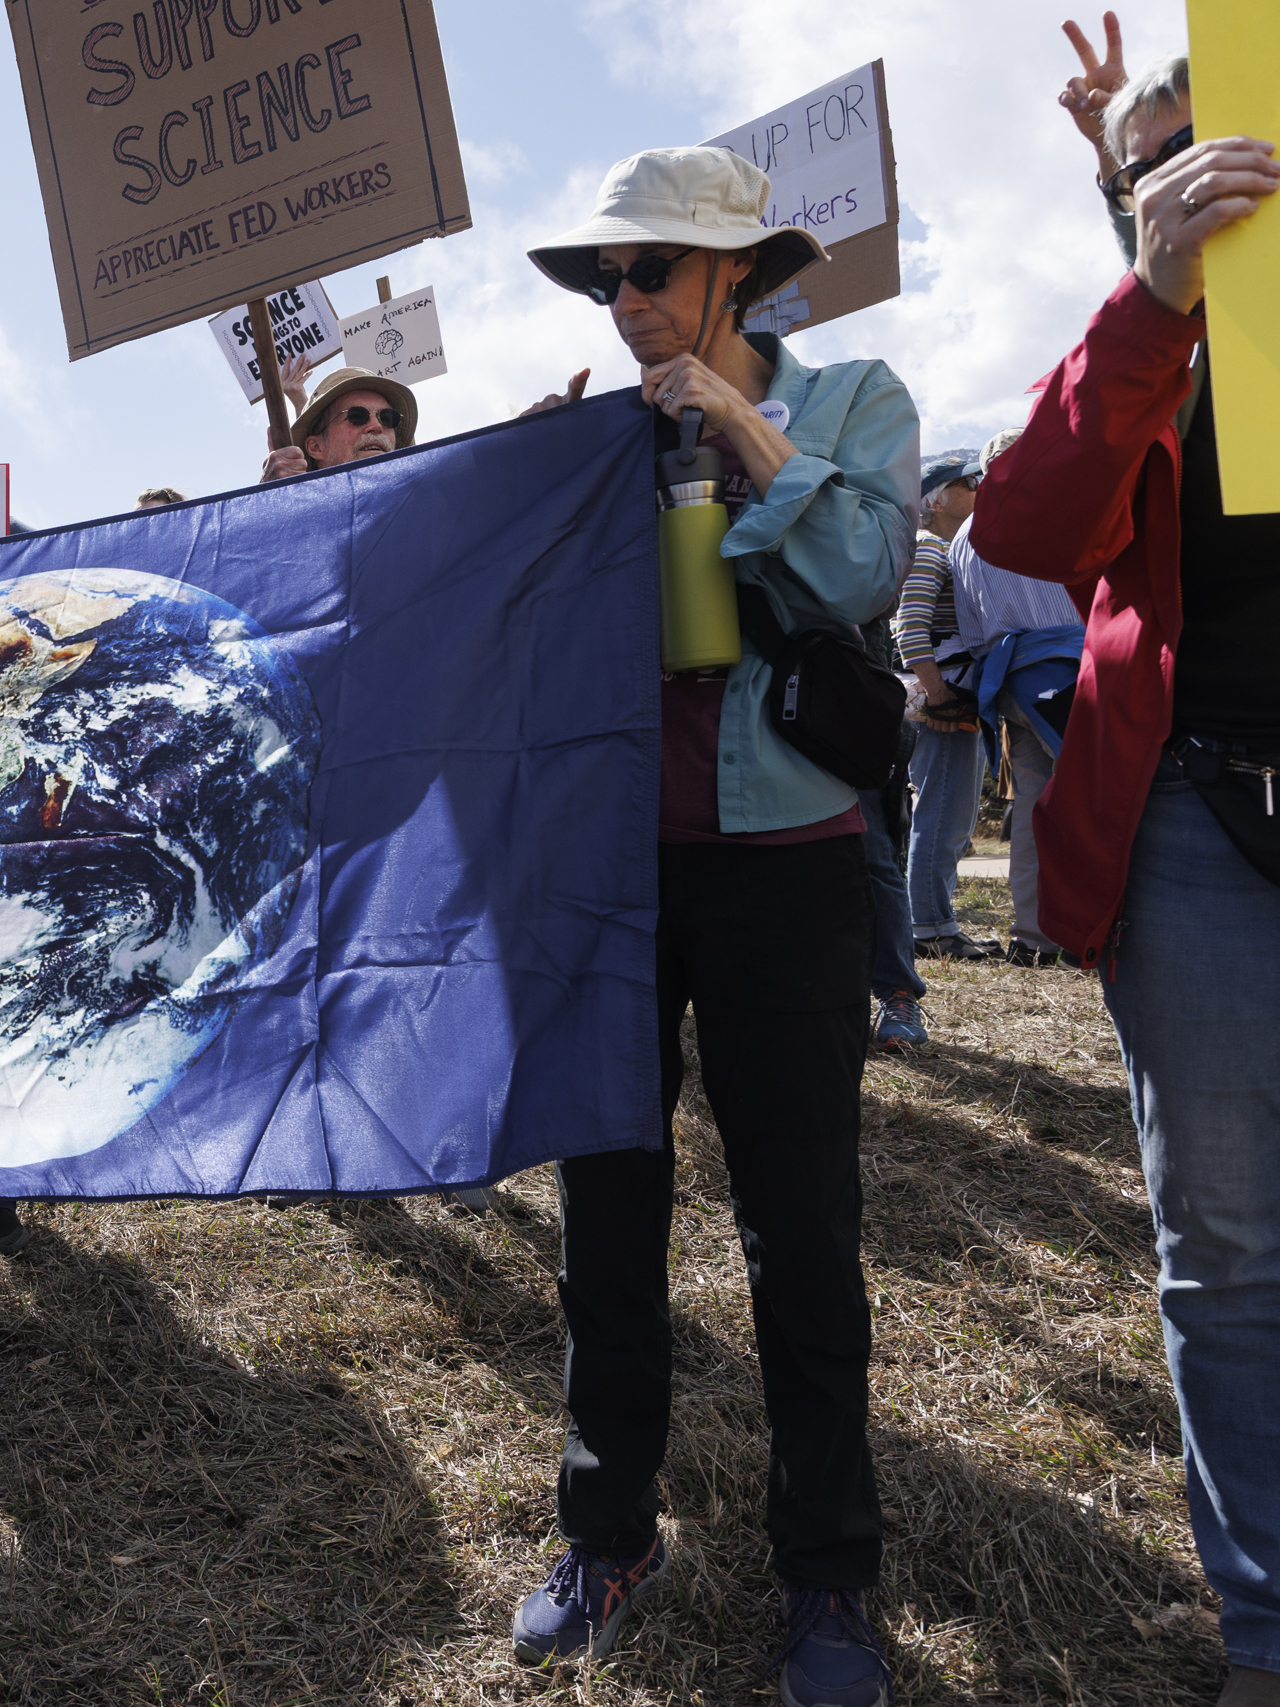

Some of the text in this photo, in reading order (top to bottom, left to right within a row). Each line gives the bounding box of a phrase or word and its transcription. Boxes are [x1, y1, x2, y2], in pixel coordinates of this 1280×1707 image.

[82, 0, 331, 106] SUPPO
[113, 34, 372, 205] SCIENCE
[751, 85, 868, 173] UP FOR
[93, 162, 392, 290] APPRECIATE FED WORKERS
[232, 287, 306, 346] SCNCE
[247, 322, 325, 381] ERYONE
[287, 316, 301, 332] TO
[344, 298, 432, 338] MAKE AMERICA
